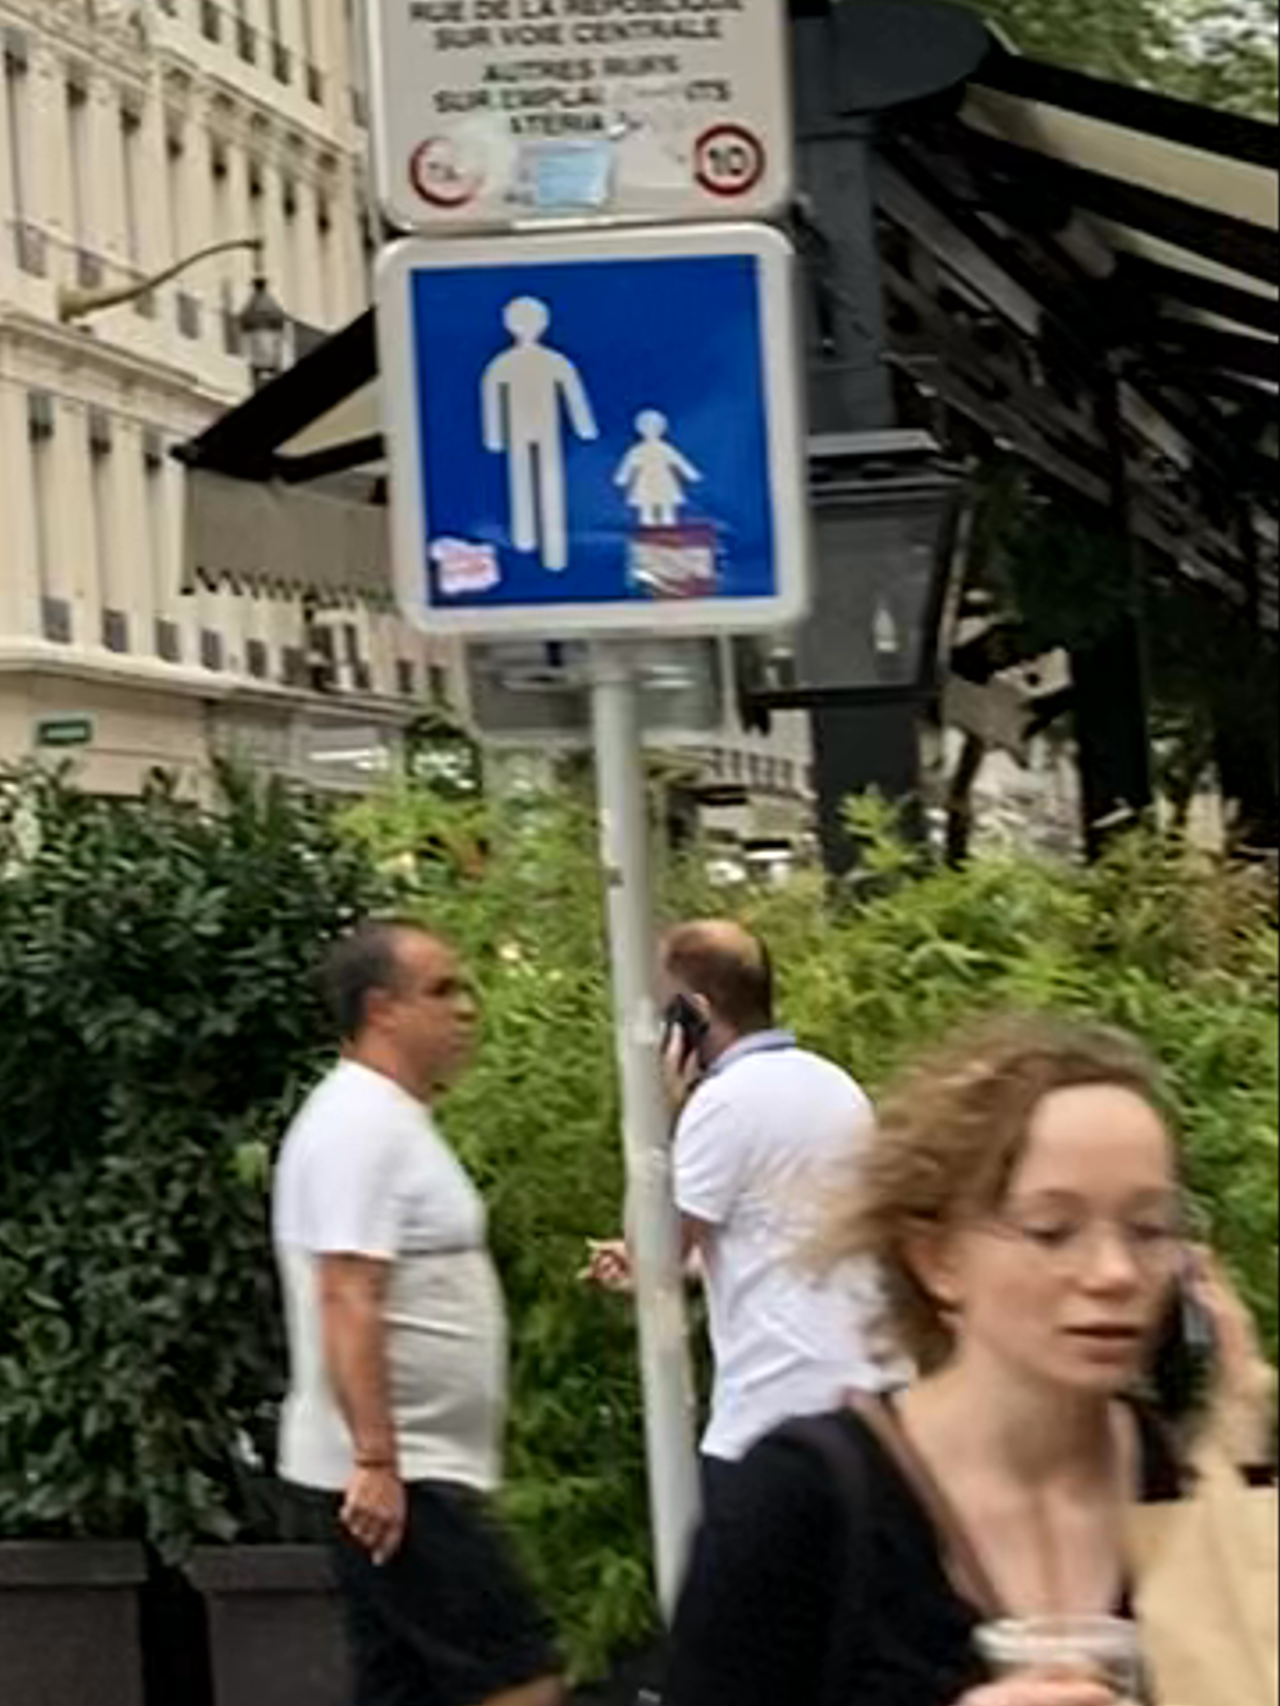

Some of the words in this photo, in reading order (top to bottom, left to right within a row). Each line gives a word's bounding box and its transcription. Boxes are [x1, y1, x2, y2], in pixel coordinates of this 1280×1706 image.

[409, 0, 464, 24] RUE
[433, 26, 492, 51] SUR
[499, 22, 564, 46] VOIE
[571, 16, 724, 45] CENTRALE
[482, 58, 596, 83] AUTRES
[433, 90, 491, 114] SUR
[709, 145, 749, 178] 10
